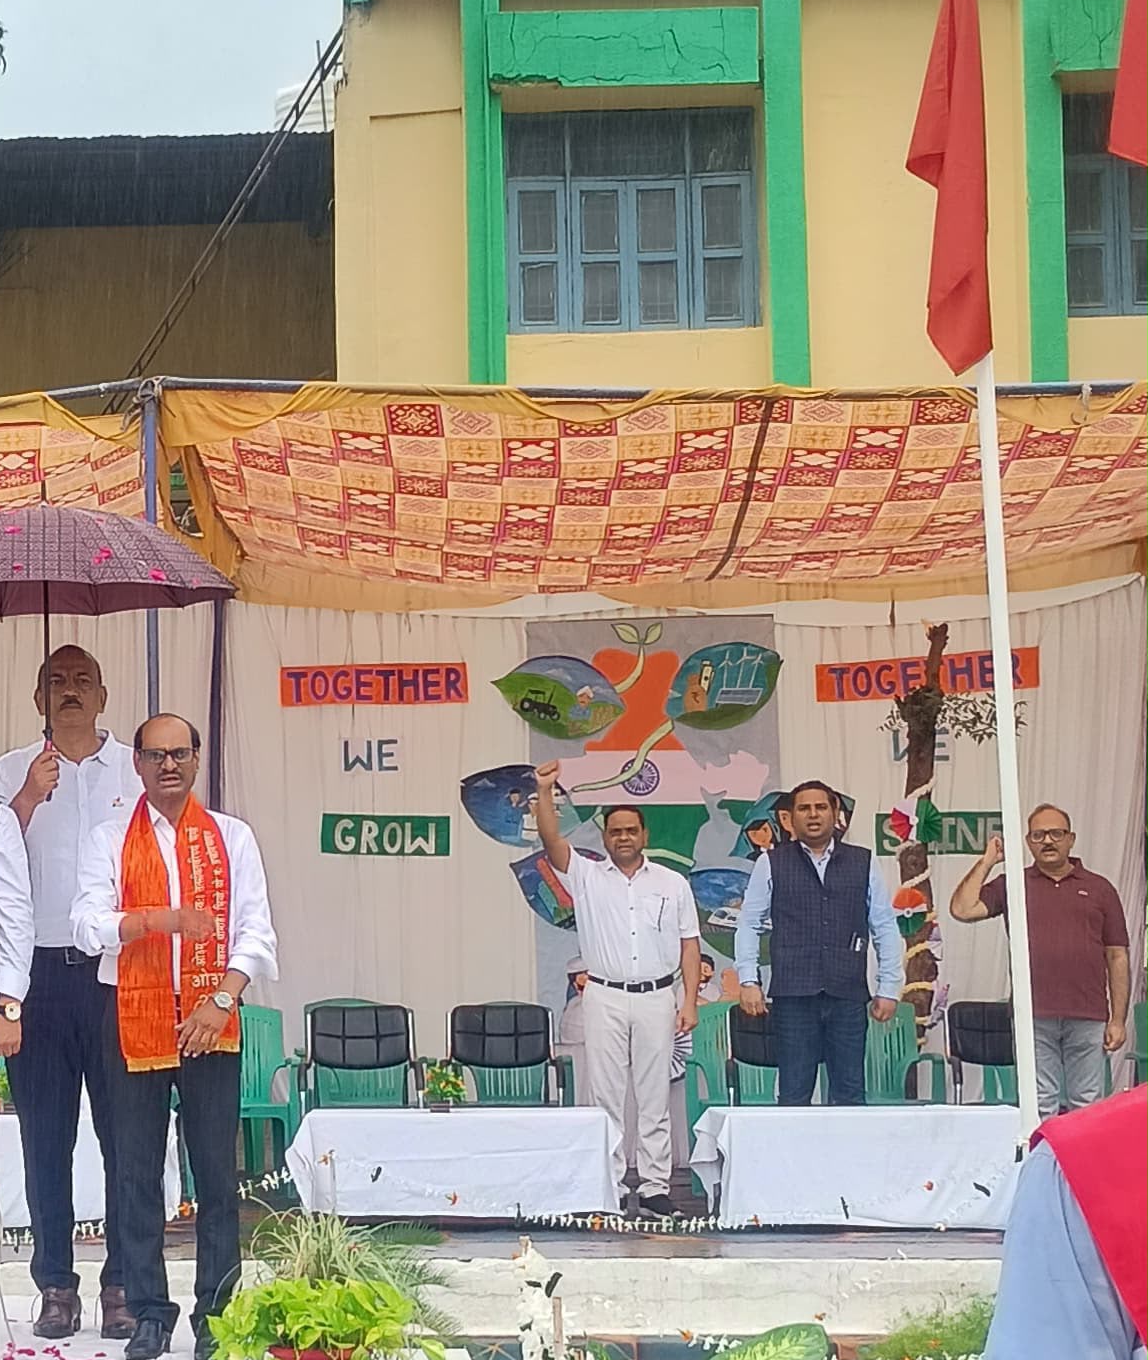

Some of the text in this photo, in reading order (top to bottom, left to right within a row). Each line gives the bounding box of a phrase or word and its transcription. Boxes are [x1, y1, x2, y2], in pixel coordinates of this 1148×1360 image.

[286, 668, 463, 703] TOGETHER
[343, 739, 399, 772] WE
[334, 819, 436, 854] GROW
